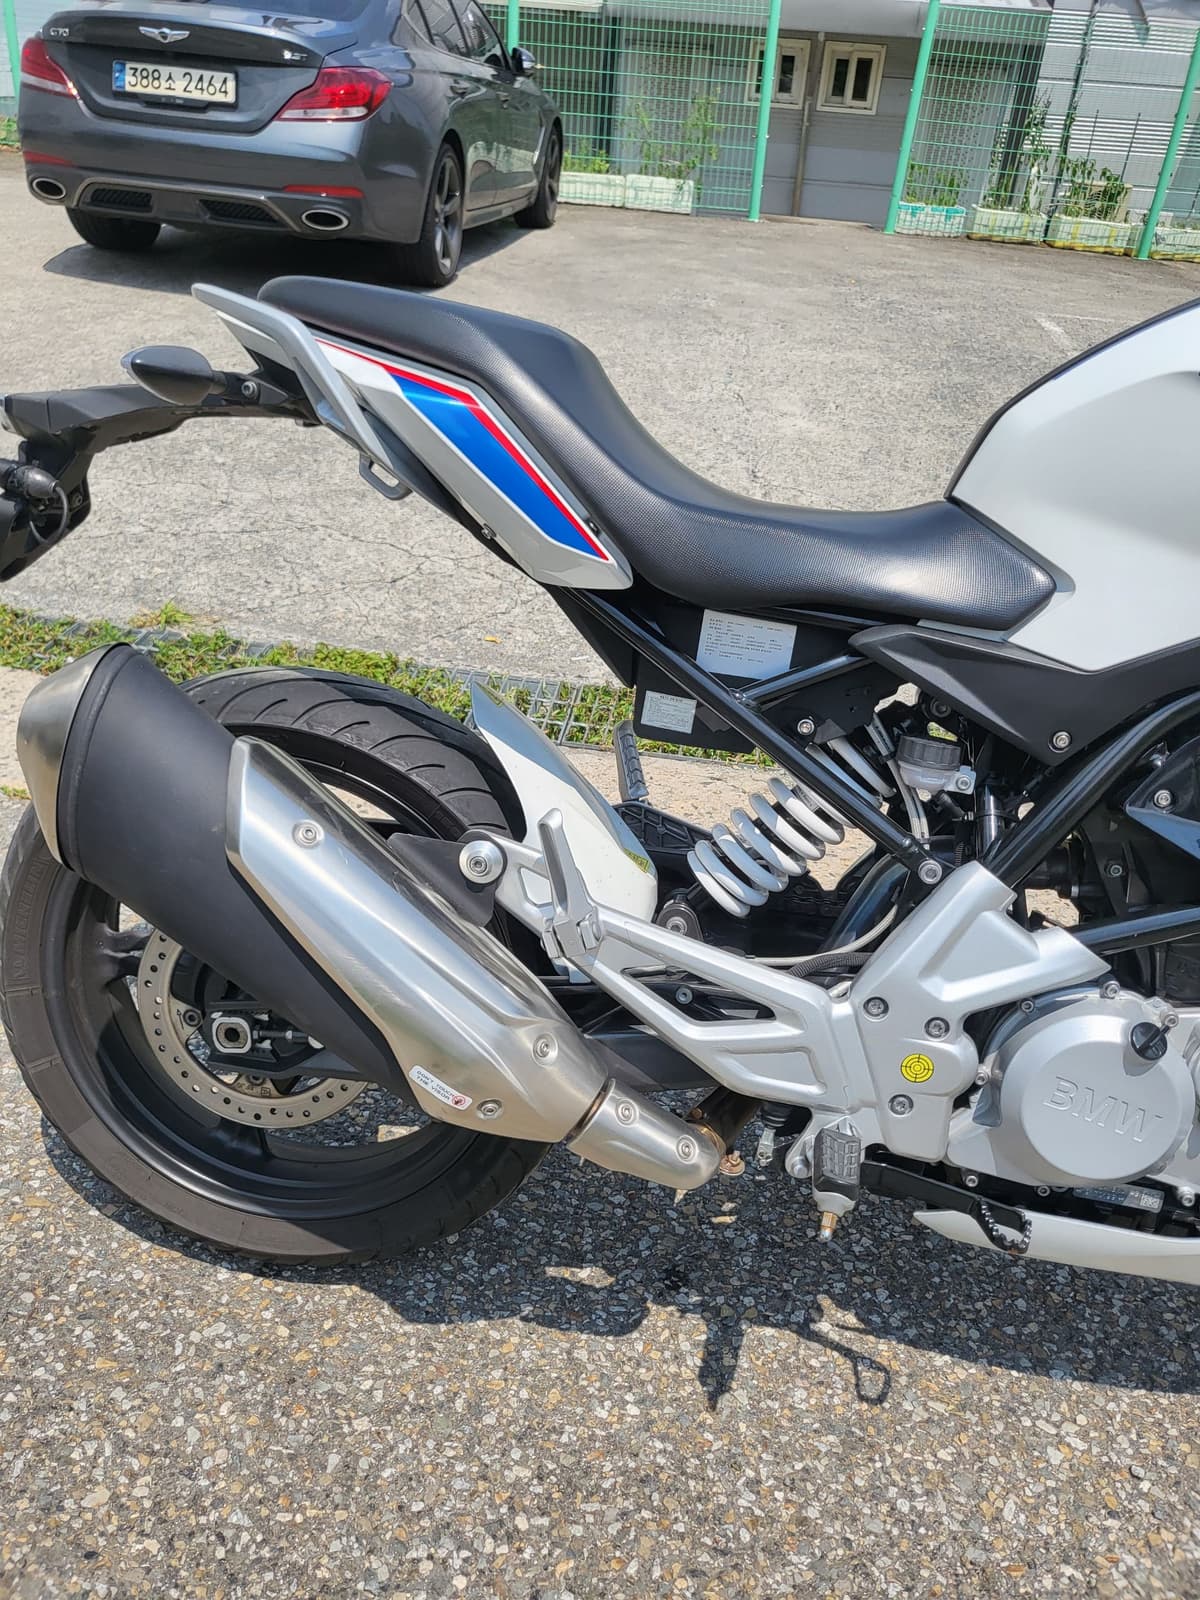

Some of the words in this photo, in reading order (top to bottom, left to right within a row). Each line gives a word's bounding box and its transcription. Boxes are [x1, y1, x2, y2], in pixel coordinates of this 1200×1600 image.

[128, 67, 177, 92] 388소
[182, 71, 229, 98] 2464
[1043, 1076, 1164, 1142] BMW
